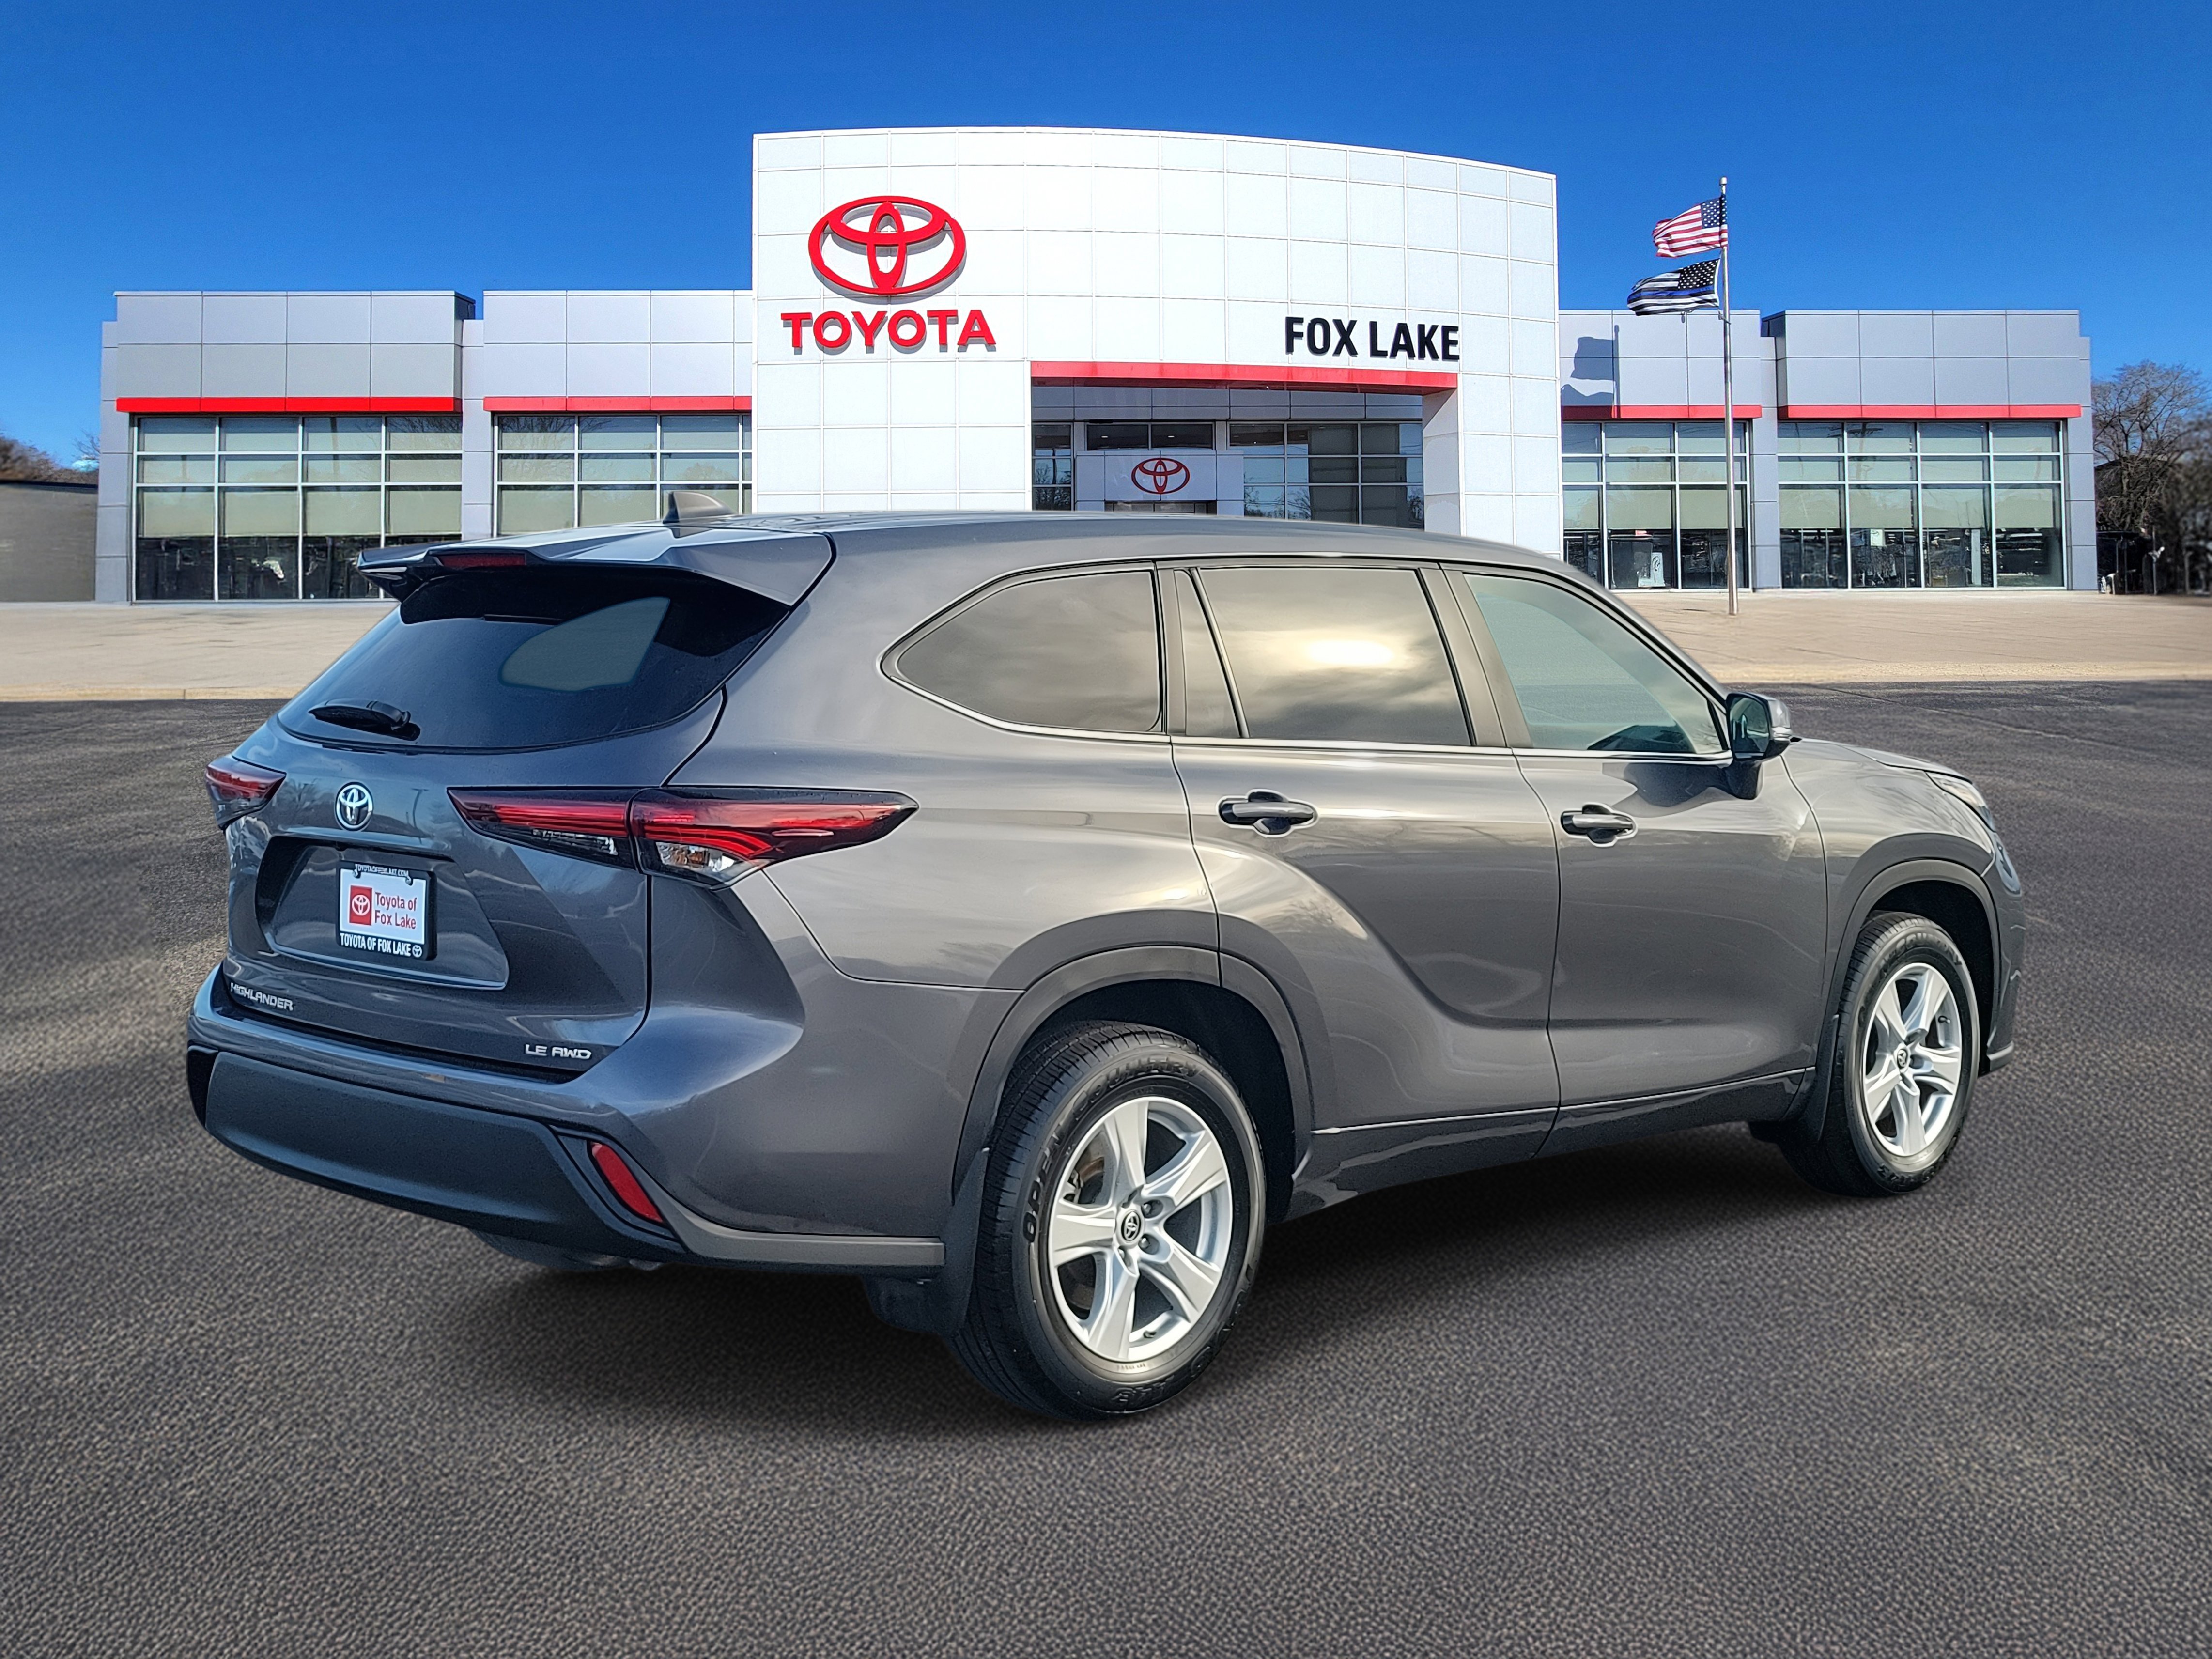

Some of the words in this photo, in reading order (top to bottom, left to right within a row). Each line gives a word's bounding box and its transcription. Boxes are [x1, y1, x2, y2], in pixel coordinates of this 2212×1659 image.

[781, 309, 997, 350] TOYOTA
[1285, 316, 1358, 356] FOX
[1369, 320, 1460, 361] LAKE
[375, 892, 405, 911] Toyota
[408, 897, 417, 911] of
[375, 910, 392, 926] Fox
[395, 912, 417, 930] Lake
[340, 932, 367, 950] TOYOTA
[367, 936, 377, 951] OF
[377, 938, 392, 953] FOX
[393, 941, 411, 957] LAKE
[230, 982, 294, 1011] HIGHLANDER
[525, 1044, 547, 1056] LE
[552, 1046, 592, 1060] AWD
